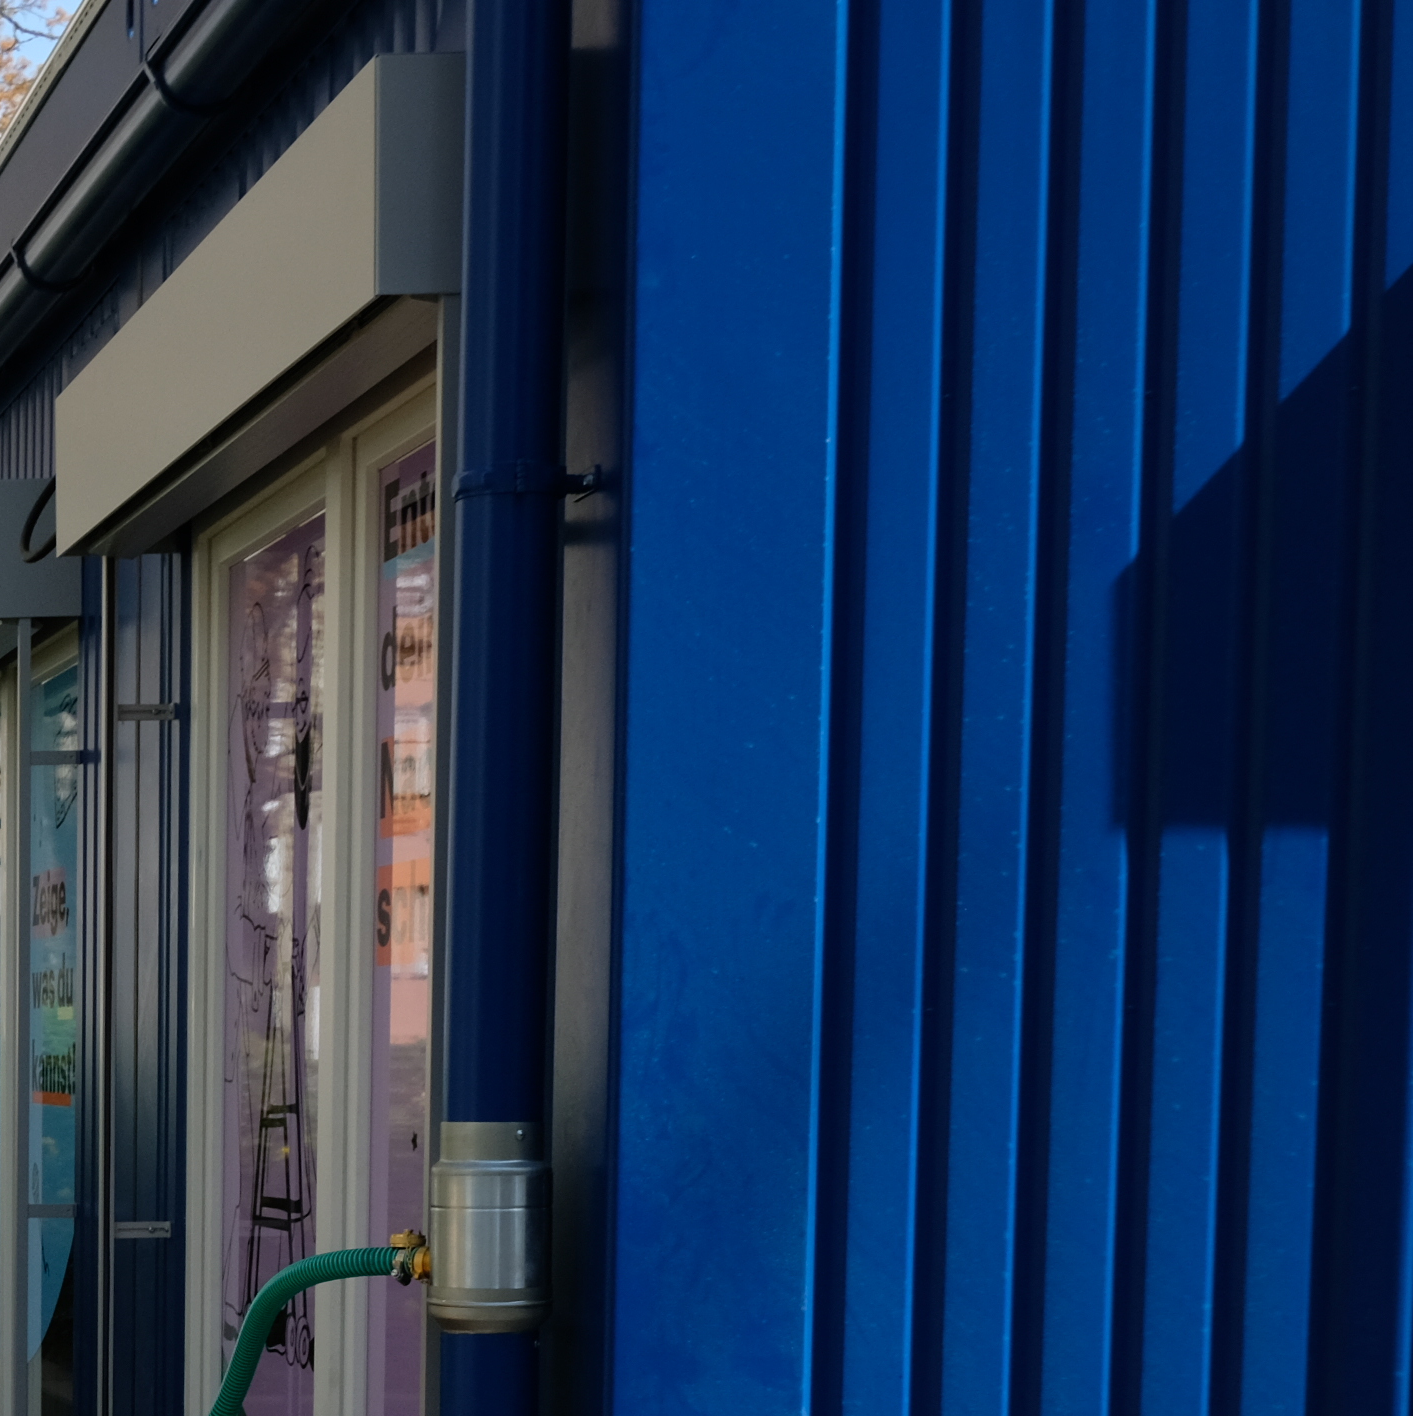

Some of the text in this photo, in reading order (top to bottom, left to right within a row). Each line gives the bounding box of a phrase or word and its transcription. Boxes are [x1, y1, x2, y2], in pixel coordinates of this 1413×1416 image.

[32, 870, 70, 935] Zeige,
[32, 952, 74, 1008] was du
[32, 1039, 76, 1094] kannst!
